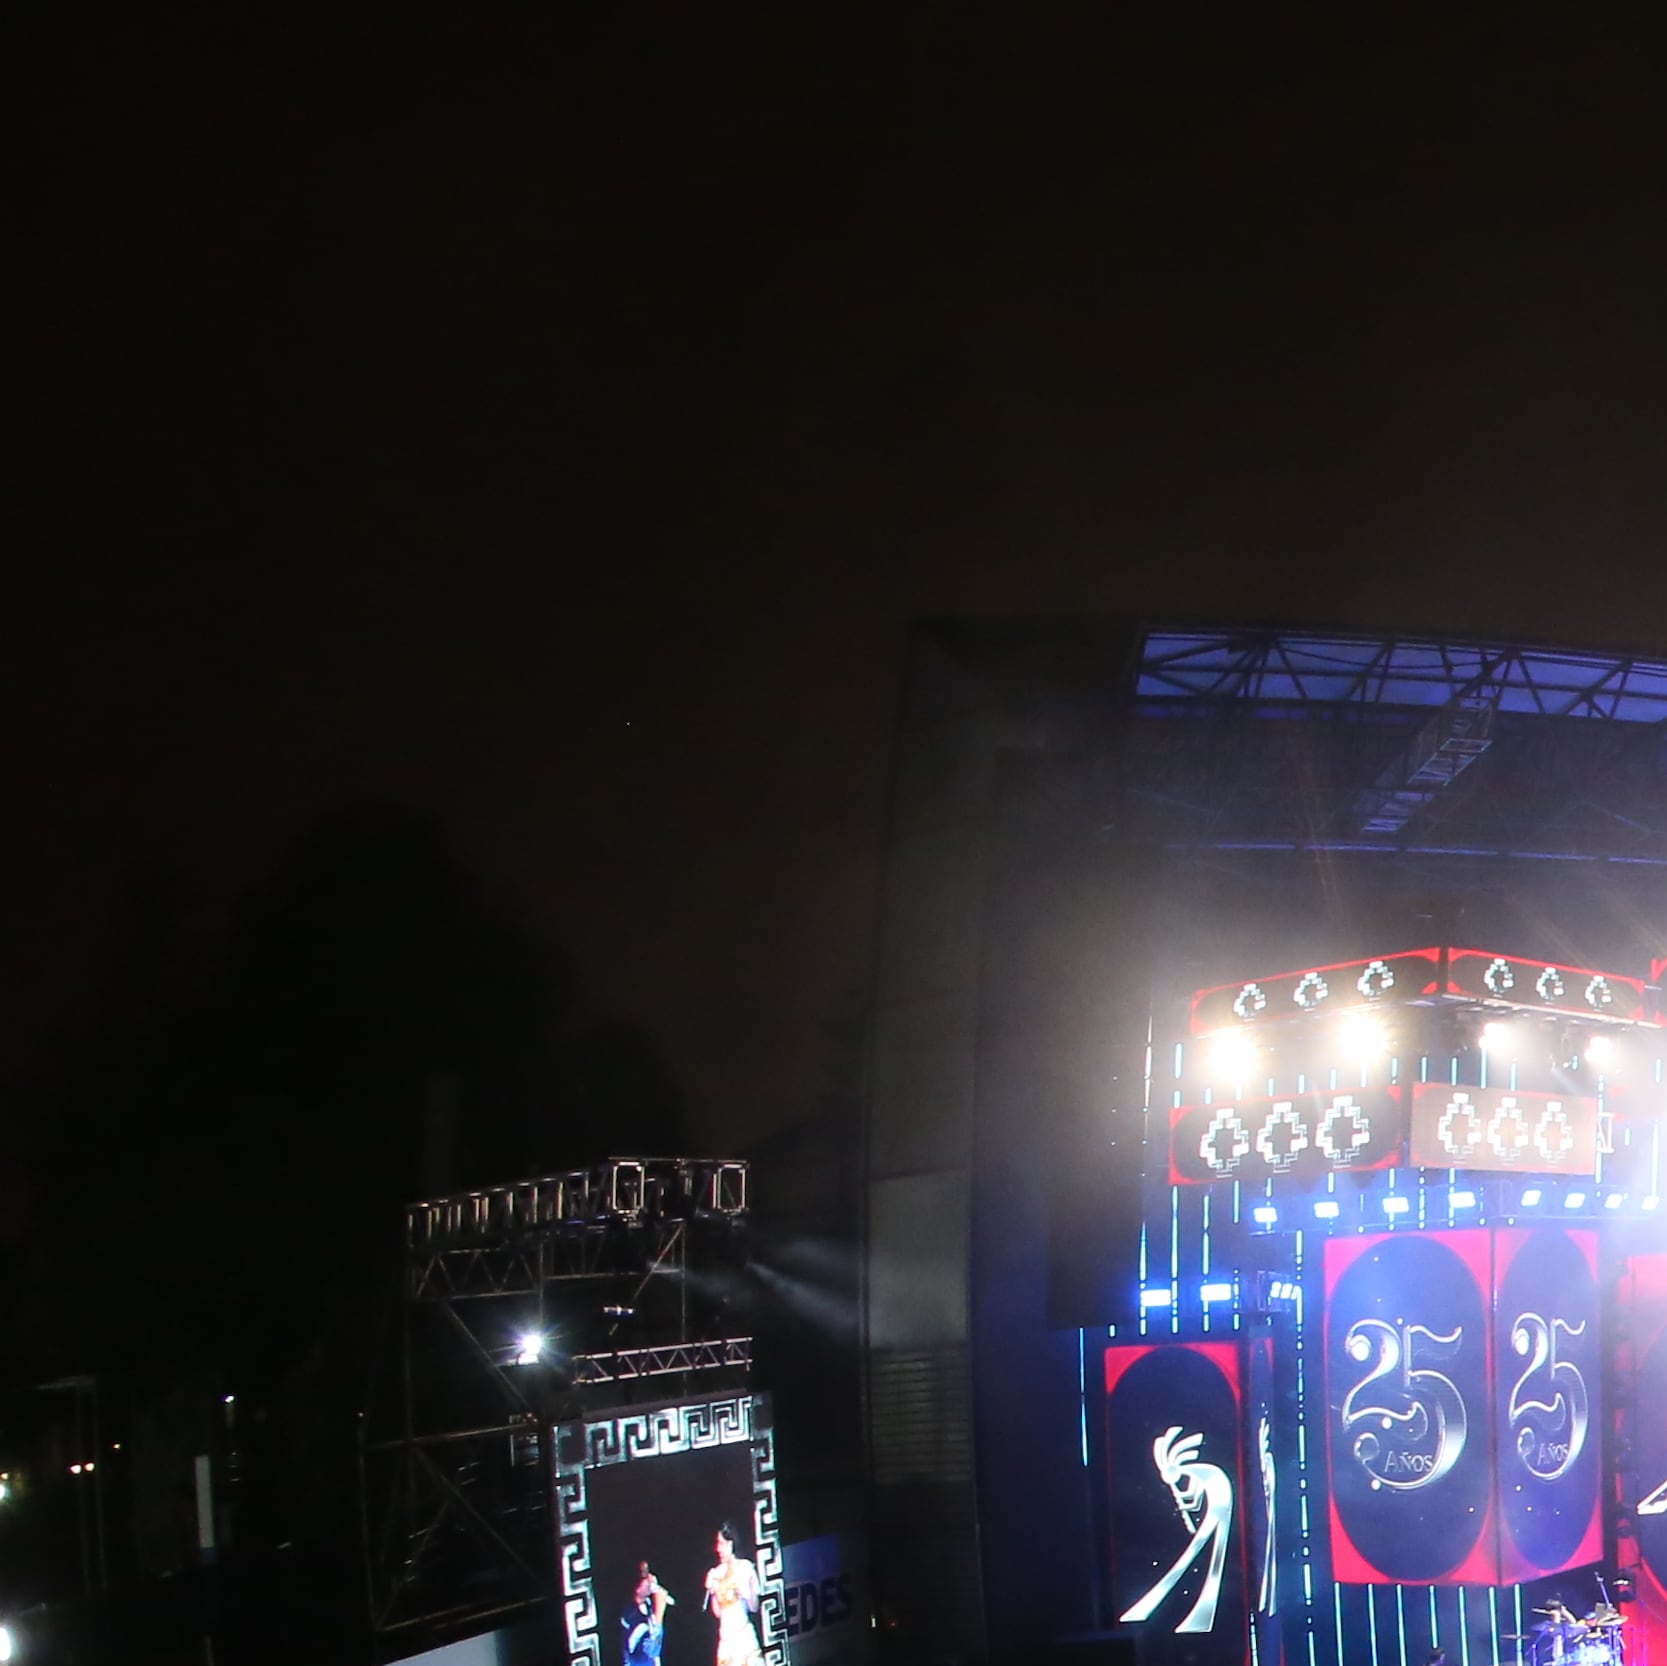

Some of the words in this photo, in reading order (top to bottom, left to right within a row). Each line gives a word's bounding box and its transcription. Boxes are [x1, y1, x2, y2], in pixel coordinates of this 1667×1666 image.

[1342, 1318, 1467, 1489] 25
[1508, 1312, 1589, 1481] 25
[1384, 1450, 1433, 1473] AÑOS
[1537, 1442, 1569, 1466] AÑOS
